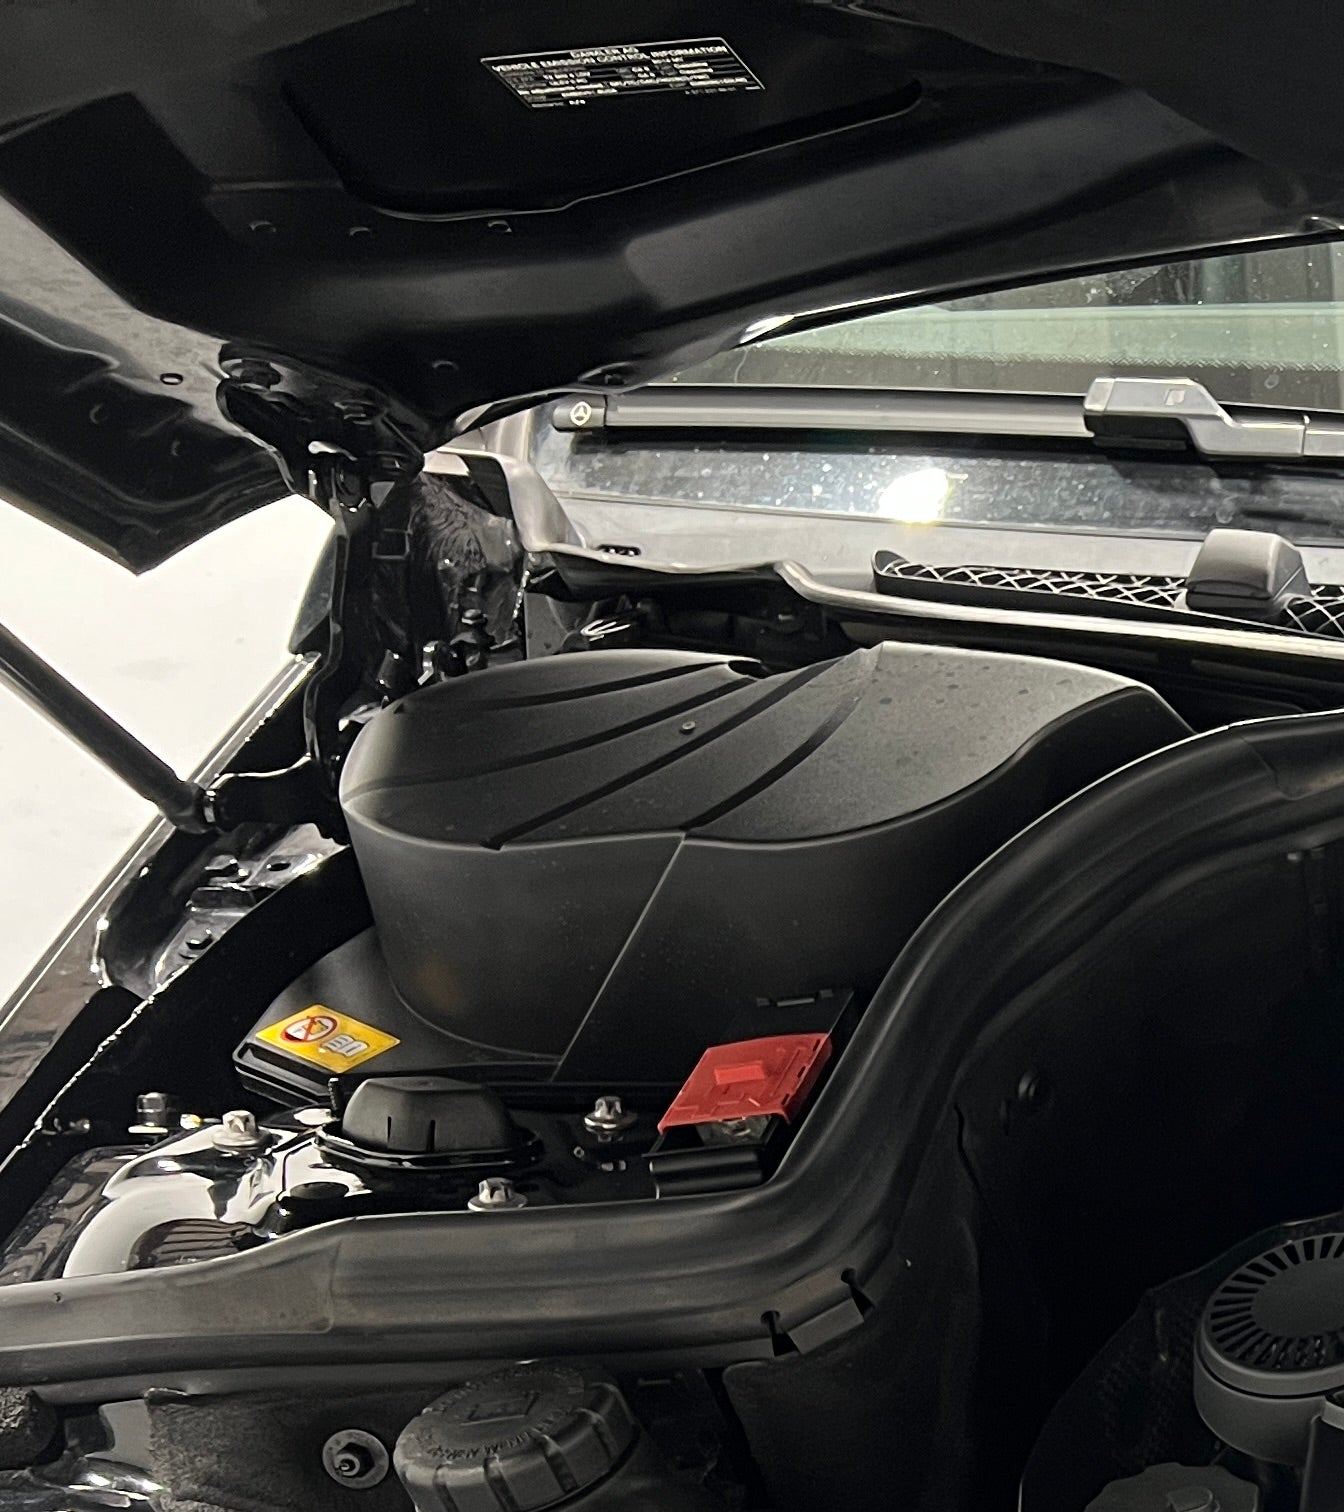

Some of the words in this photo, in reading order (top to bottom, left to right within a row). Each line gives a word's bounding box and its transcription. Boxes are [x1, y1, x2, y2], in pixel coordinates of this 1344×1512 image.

[491, 61, 540, 72] VEHICLE
[596, 52, 650, 62] CONTROL
[650, 45, 729, 58] INFORMATION
